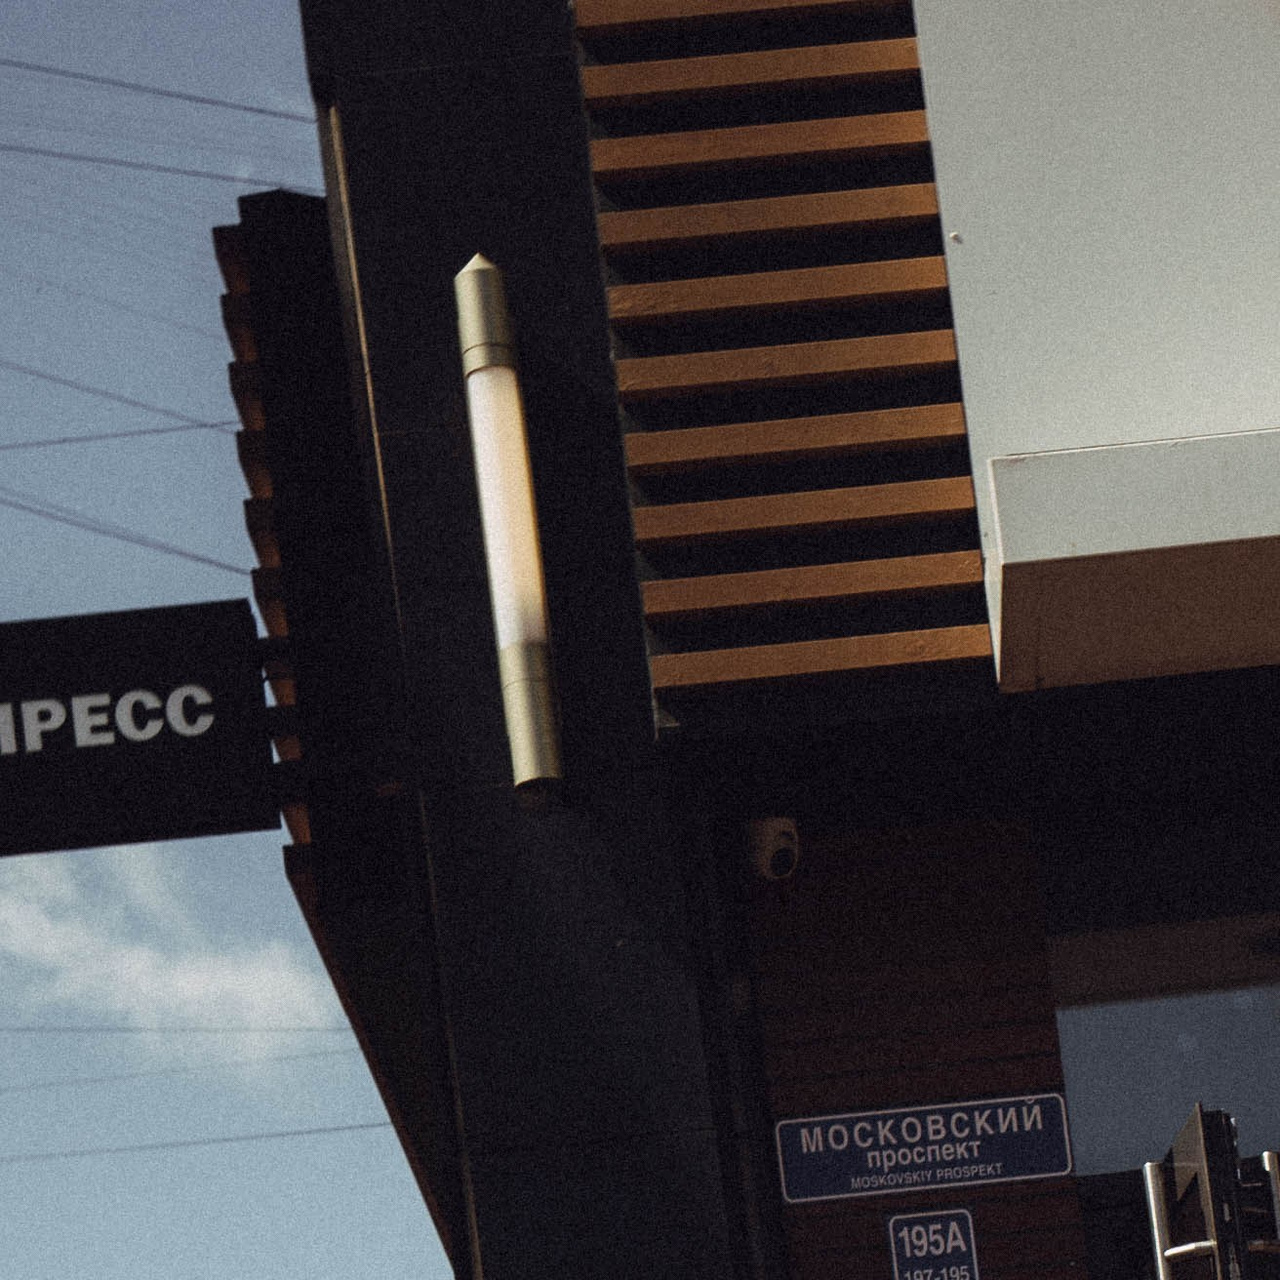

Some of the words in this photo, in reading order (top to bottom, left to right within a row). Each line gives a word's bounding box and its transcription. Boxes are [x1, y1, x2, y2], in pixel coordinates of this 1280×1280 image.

[800, 1098, 1043, 1154] МОСКОВСКИЙ
[867, 1141, 981, 1172] проспект
[850, 1169, 932, 1189] MOSKOVSKIY
[936, 1162, 1003, 1181] PROSPEKT
